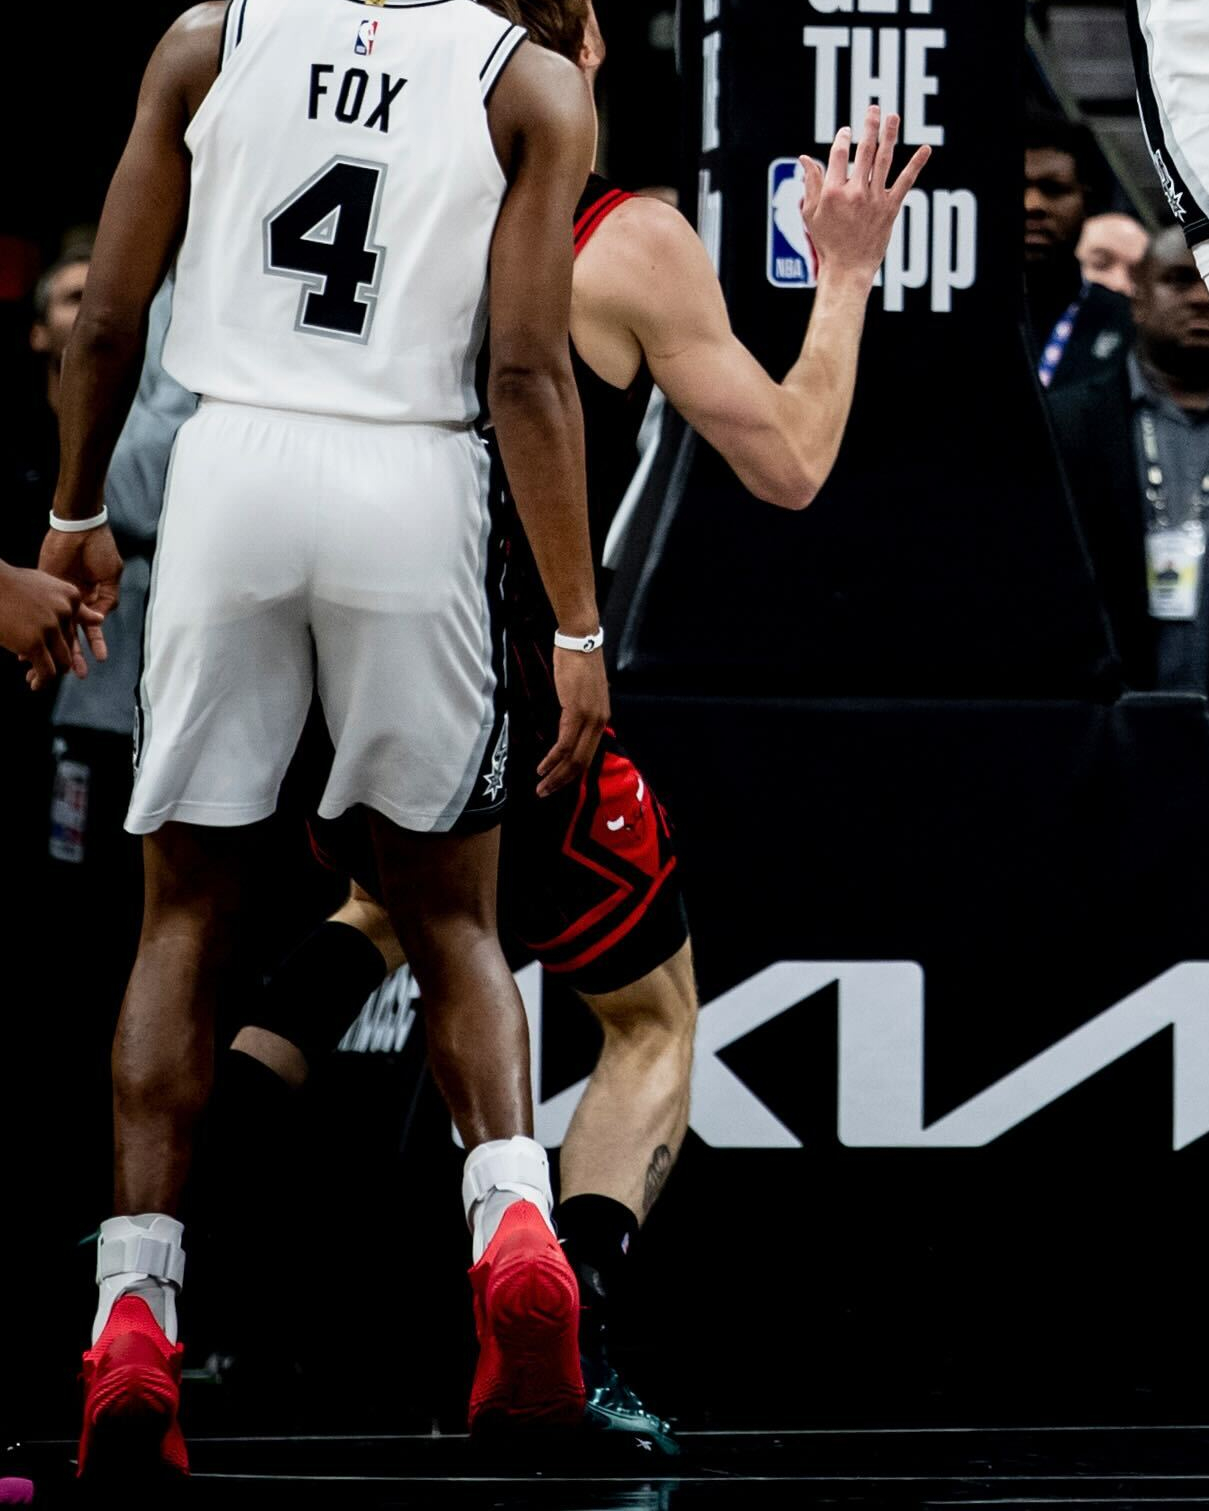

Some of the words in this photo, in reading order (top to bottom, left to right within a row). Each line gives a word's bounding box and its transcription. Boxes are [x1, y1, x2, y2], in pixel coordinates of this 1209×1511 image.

[307, 63, 408, 133] FOX
[803, 25, 947, 147] THE
[262, 153, 389, 346] 4
[860, 164, 978, 312] pp
